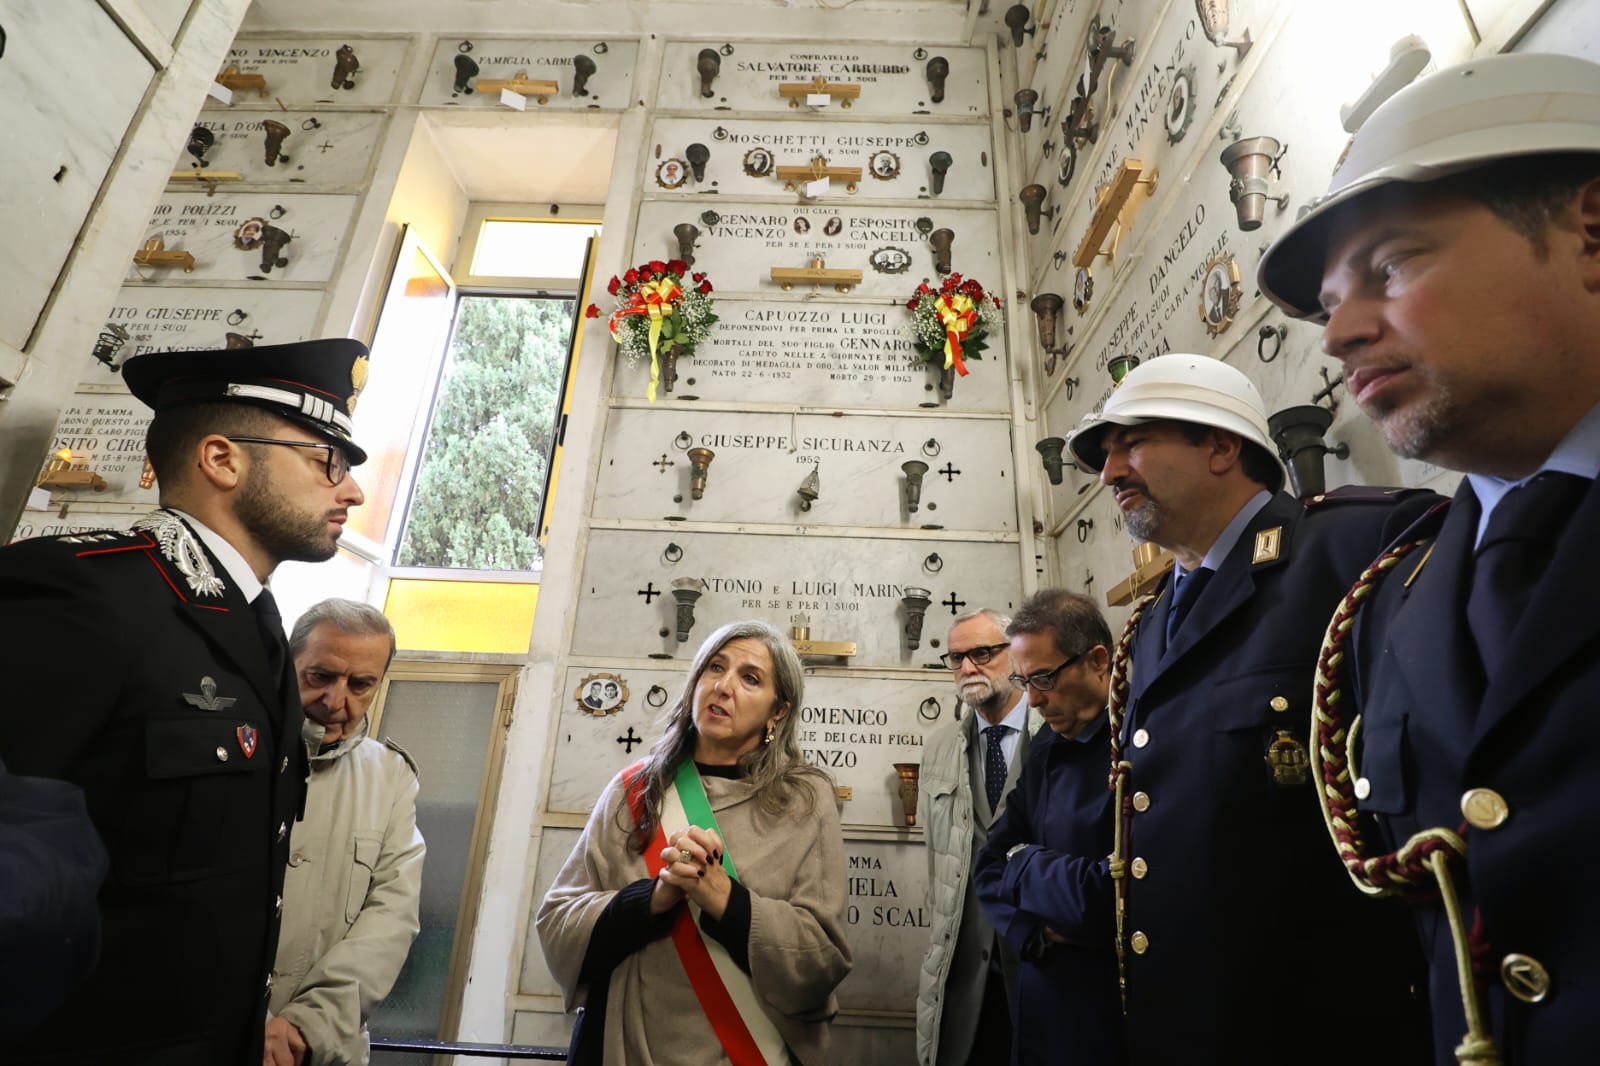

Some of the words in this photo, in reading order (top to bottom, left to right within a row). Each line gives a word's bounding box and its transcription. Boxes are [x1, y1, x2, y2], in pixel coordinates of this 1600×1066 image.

[258, 48, 330, 58] VINCENZO
[478, 56, 531, 65] FAMIGLIA
[736, 62, 822, 73] SALVATORE
[1128, 19, 1196, 151] VINCENZO
[728, 134, 826, 146] MOSCHETTI
[837, 135, 915, 148] GIUSEPPE
[182, 205, 237, 216] POLIZZI
[178, 218, 196, 226] PER
[215, 218, 238, 226] SUOI
[720, 214, 788, 226] GENNARO
[849, 217, 916, 229] ESPOSITO
[708, 226, 786, 239] VINCENZO
[850, 230, 929, 242] CANCELLO
[845, 242, 867, 250] SUOI
[1164, 286, 1190, 321] CARA
[108, 306, 138, 320] ITO
[145, 307, 224, 321] GIUSEPPE
[744, 309, 831, 323] CAPUOZZO
[841, 311, 886, 325] LUIGI
[1130, 320, 1146, 345] PER
[1150, 285, 1171, 318] SUOI
[130, 323, 151, 331] PER
[161, 323, 188, 332] SUOI
[719, 323, 783, 333] DEPONENDOVI
[812, 326, 838, 334] PRIMA
[1095, 300, 1140, 373] GIUSEPPE
[712, 339, 752, 347] MORTALI
[804, 341, 835, 349] FIGLIO
[840, 338, 912, 351] GENNARO
[738, 350, 778, 358] CADUTO
[783, 351, 816, 359] NELLE
[831, 353, 881, 361] GIORNATE
[693, 359, 736, 367] DECORATO
[755, 360, 801, 369] MEDAGLIA
[830, 373, 858, 381] MORTO
[97, 408, 134, 417] MAMMA
[92, 418, 130, 427] QUESTO
[97, 428, 122, 436] CARO
[106, 438, 146, 453] CIRO
[701, 434, 788, 451] GIUSEPPE
[802, 437, 905, 454] SICURANZA
[795, 455, 821, 465] 1952
[71, 463, 89, 472] PER
[101, 464, 126, 473] SUOI
[772, 585, 780, 595] E
[792, 581, 837, 598] LUIGI
[853, 583, 904, 598] MARIN
[741, 599, 762, 609] PER
[768, 600, 780, 609] SE
[786, 600, 793, 610] E
[799, 601, 819, 610] PER
[825, 601, 829, 611] I
[834, 602, 859, 611] SUOI
[801, 706, 888, 726] OMENICO
[824, 732, 846, 744] DEI
[849, 733, 882, 745] CARI
[888, 734, 924, 746] FIGLI
[802, 750, 857, 768] ENZO
[872, 906, 931, 928] SCAL
